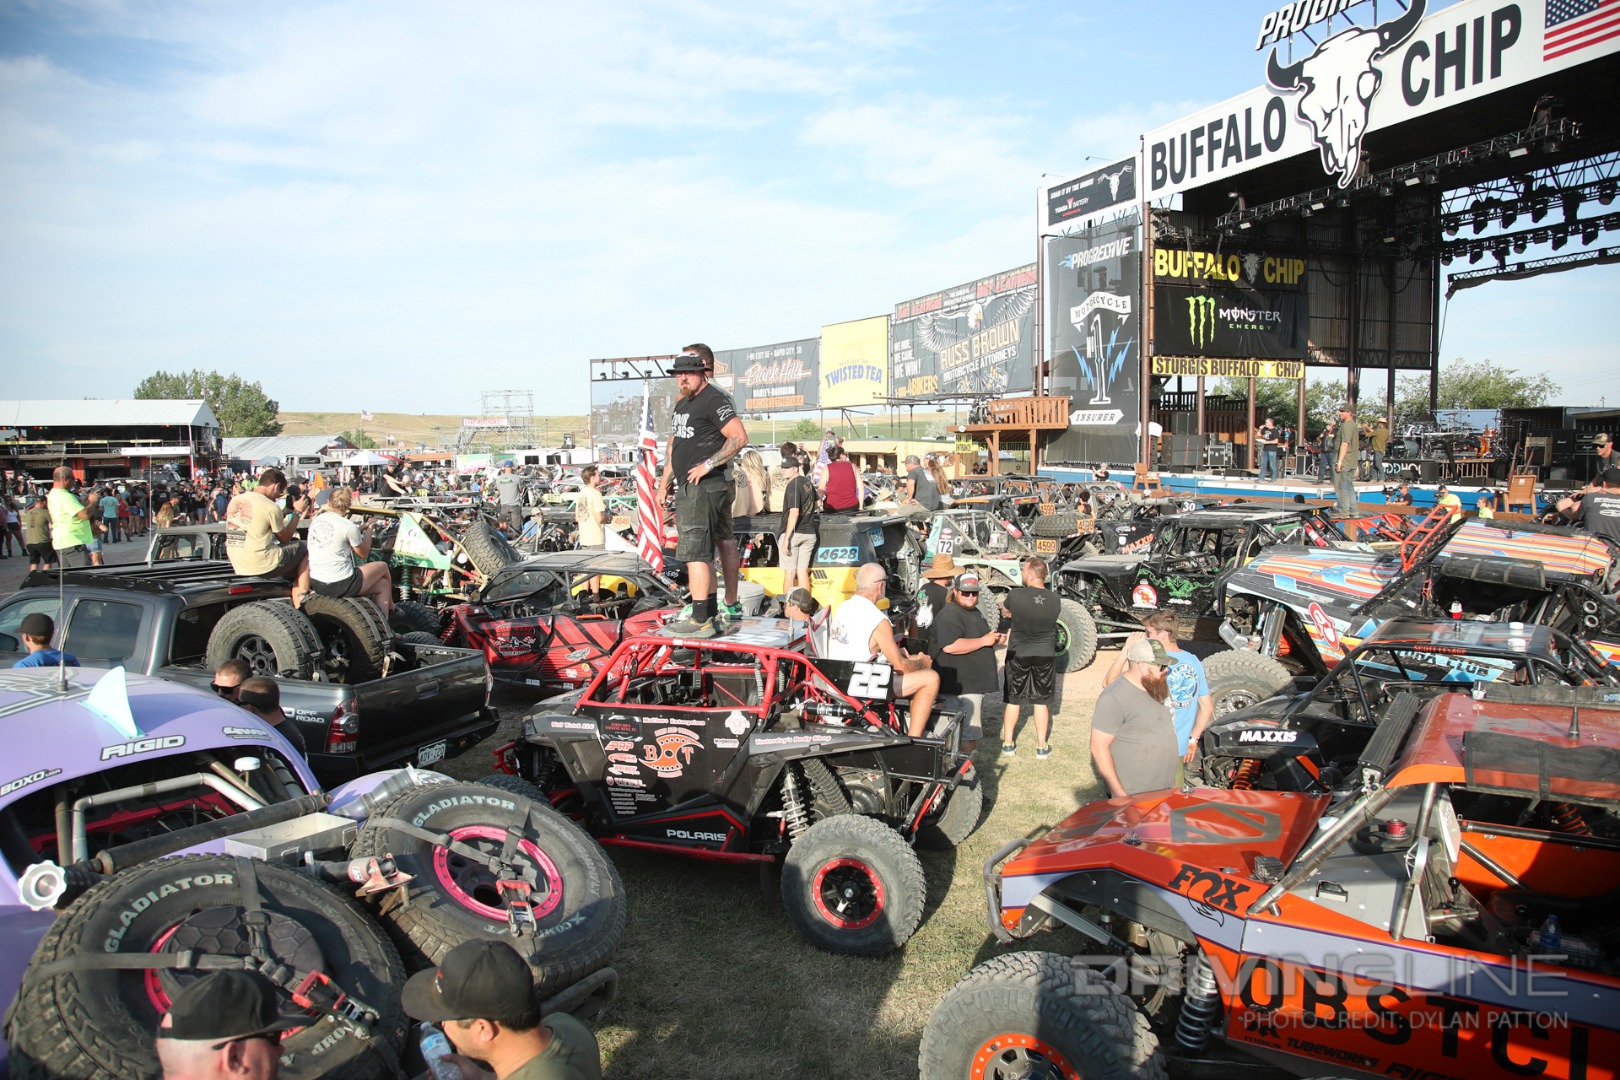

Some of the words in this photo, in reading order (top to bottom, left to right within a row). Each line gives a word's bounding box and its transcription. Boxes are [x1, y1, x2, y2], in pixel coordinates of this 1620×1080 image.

[1151, 95, 1287, 192] BUFFALO
[1400, 4, 1522, 107] CHIP
[1071, 236, 1134, 270] PROGRESSIVE
[1154, 248, 1241, 282] BUFFALO
[1263, 256, 1305, 285] CHIP
[1074, 295, 1128, 318] MOTORCYCLE
[1219, 306, 1282, 323] MONSTER
[941, 338, 970, 371] RUSS
[972, 319, 1021, 358] BROWN
[744, 360, 780, 388] Black
[780, 356, 805, 383] Hills
[894, 364, 904, 379] WE
[943, 358, 980, 381] MOTORCYCLE
[980, 345, 1017, 369] ATTORNEYS
[1156, 357, 1209, 375] STURGIS
[1209, 359, 1260, 377] BUFFALO
[1275, 362, 1301, 377] CHIP
[825, 364, 865, 389] TWISTED
[865, 364, 883, 384] TEA
[753, 386, 796, 398] HARLEY-DAVIDSON
[1076, 412, 1116, 423] INSURER
[1183, 501, 1196, 511] 30
[819, 548, 858, 561] 4628
[940, 540, 952, 553] 72
[1037, 541, 1056, 552] 4599
[1122, 533, 1154, 554] MAXXIS
[847, 662, 892, 700] 22
[295, 715, 325, 723] ROAD
[606, 741, 634, 751] PRP
[793, 735, 811, 743] Body
[1239, 730, 1298, 743] MAXXIS
[101, 735, 186, 761] RIGID
[0, 770, 46, 797] BOXO
[45, 768, 62, 777] USA
[412, 795, 516, 828] GLADIATOR
[666, 828, 728, 842] POLARIS
[1168, 863, 1251, 914] FOX
[104, 873, 234, 953] GLADIATOR
[1286, 1036, 1381, 1068] TUBEWORKS
